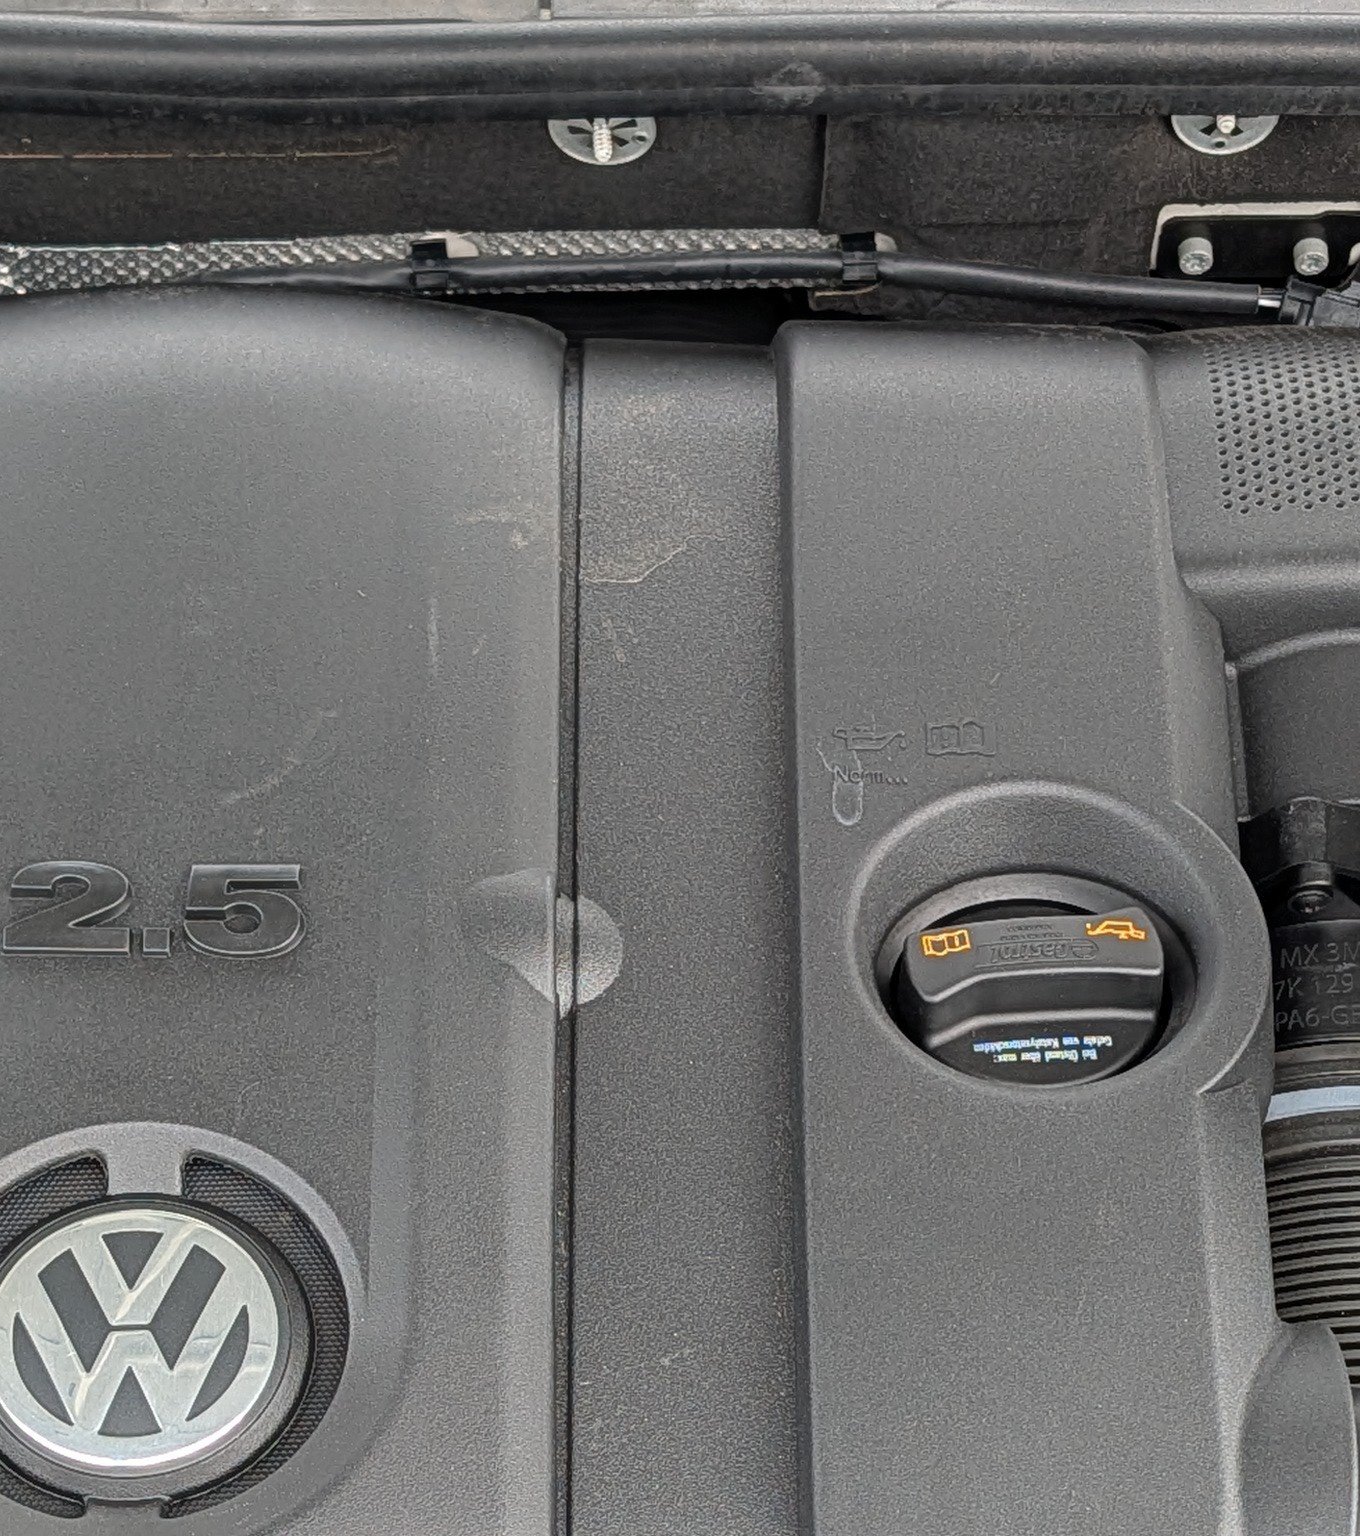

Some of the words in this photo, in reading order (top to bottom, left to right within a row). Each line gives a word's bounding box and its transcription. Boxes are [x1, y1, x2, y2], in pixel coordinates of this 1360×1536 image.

[0, 859, 308, 960] 2.5
[990, 941, 1068, 964] Castrol
[1281, 943, 1319, 968] MX
[1311, 973, 1353, 995] 129
